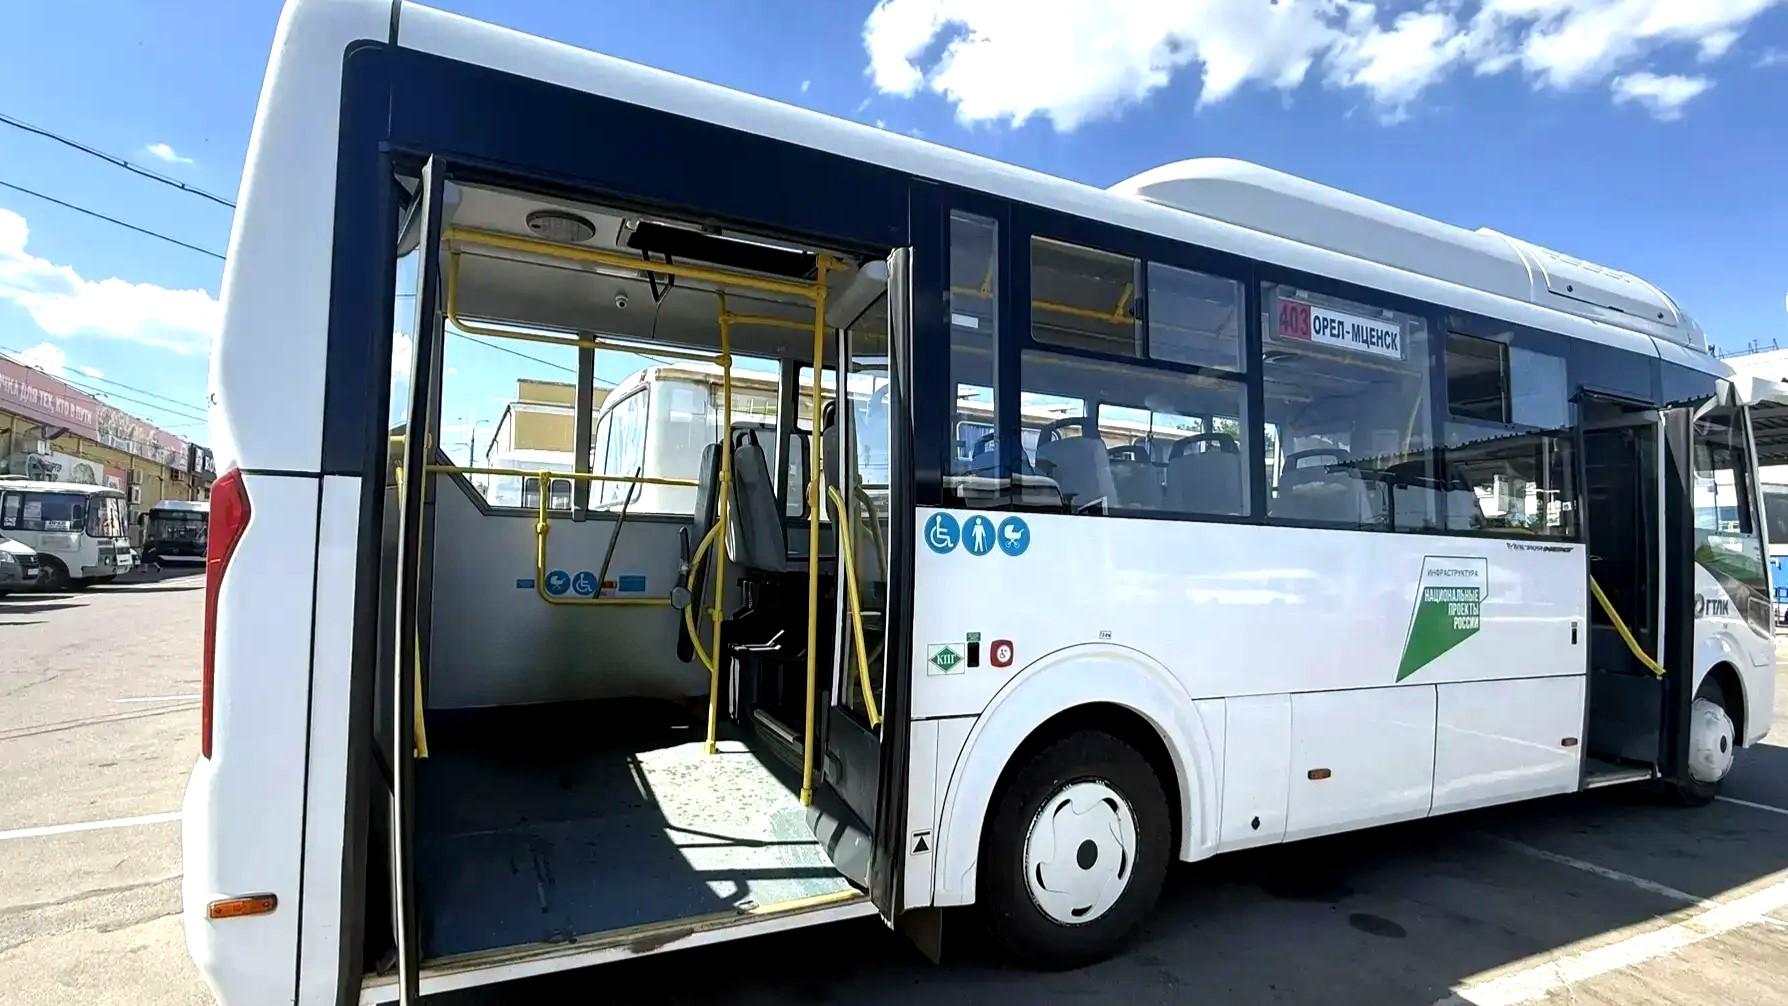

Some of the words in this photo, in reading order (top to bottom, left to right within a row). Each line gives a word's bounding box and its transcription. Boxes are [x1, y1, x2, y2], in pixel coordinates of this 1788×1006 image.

[1280, 302, 1308, 336] 403
[1312, 314, 1398, 351] ОРЕЛ-МЦЕНСК
[55, 396, 70, 416] КТО
[1427, 568, 1479, 577] ИНФРАСТРУКТУРА
[1424, 588, 1479, 604] НАЦИОНАЛЬНЫЕ
[1448, 602, 1479, 616] ПРОЕКТЫ
[1453, 616, 1479, 630] РОССИИ
[937, 653, 956, 665] КПГ
